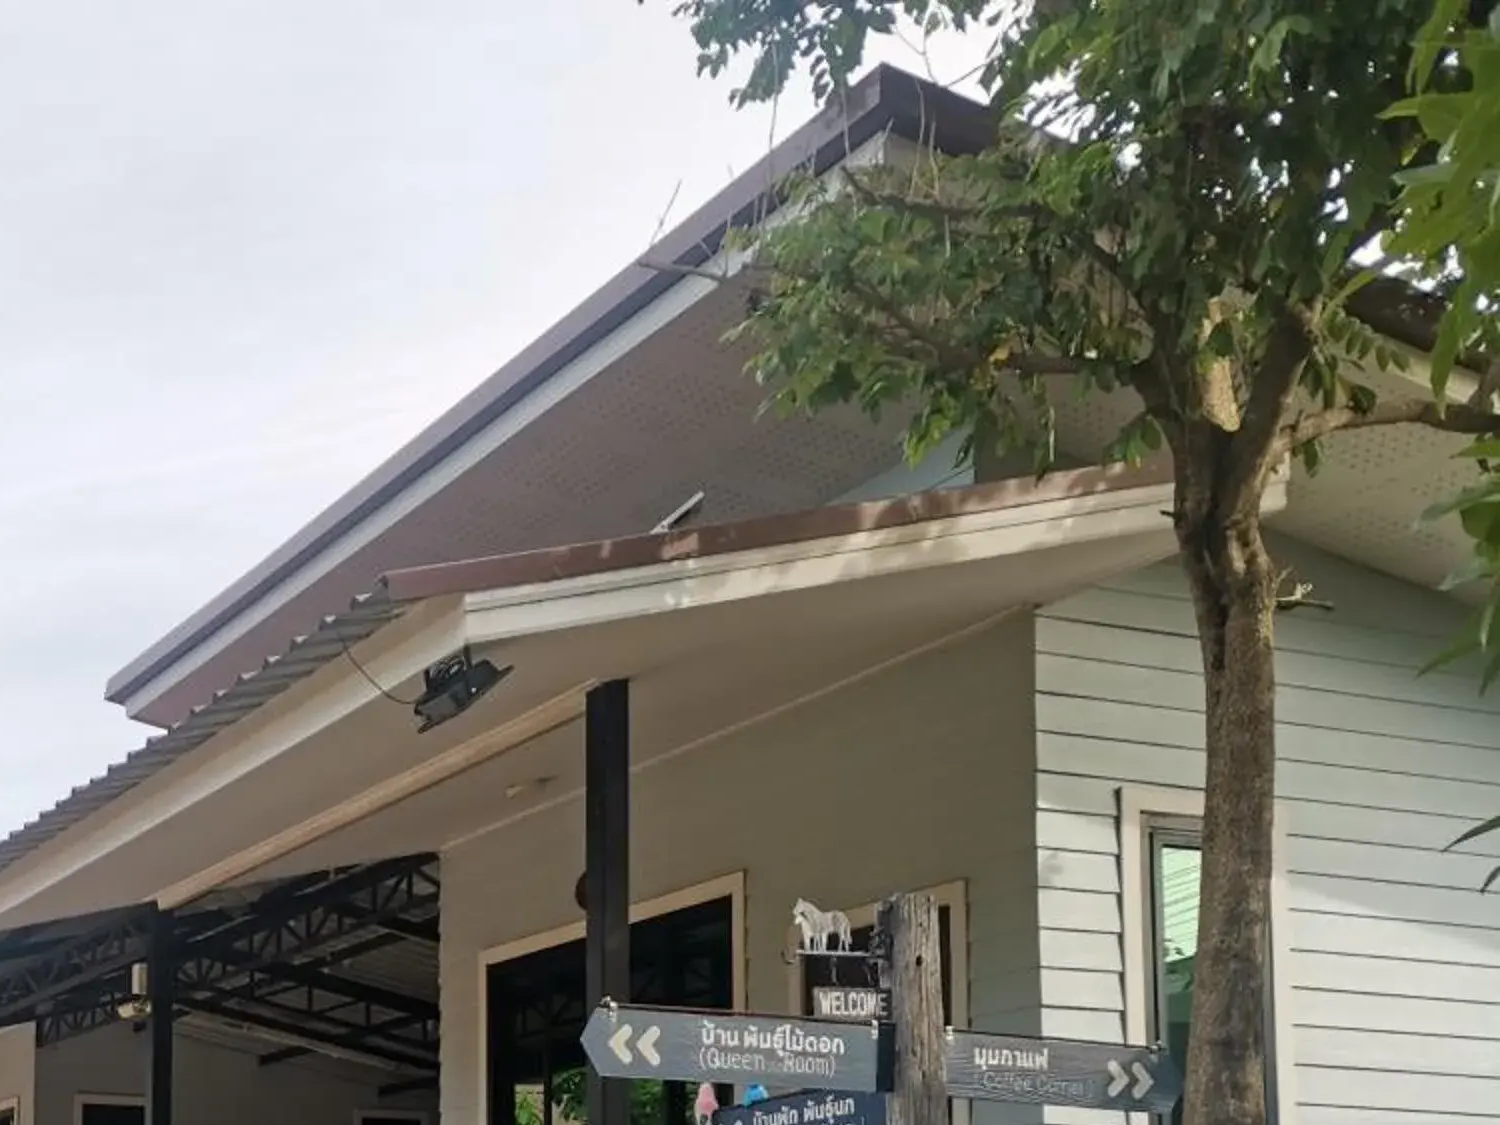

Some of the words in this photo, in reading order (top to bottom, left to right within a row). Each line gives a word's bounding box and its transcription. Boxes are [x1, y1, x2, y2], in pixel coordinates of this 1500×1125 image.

[819, 991, 888, 1016] WELCOME
[701, 1020, 740, 1046] บ้าน
[974, 1047, 1049, 1070] มุมกาแฟ
